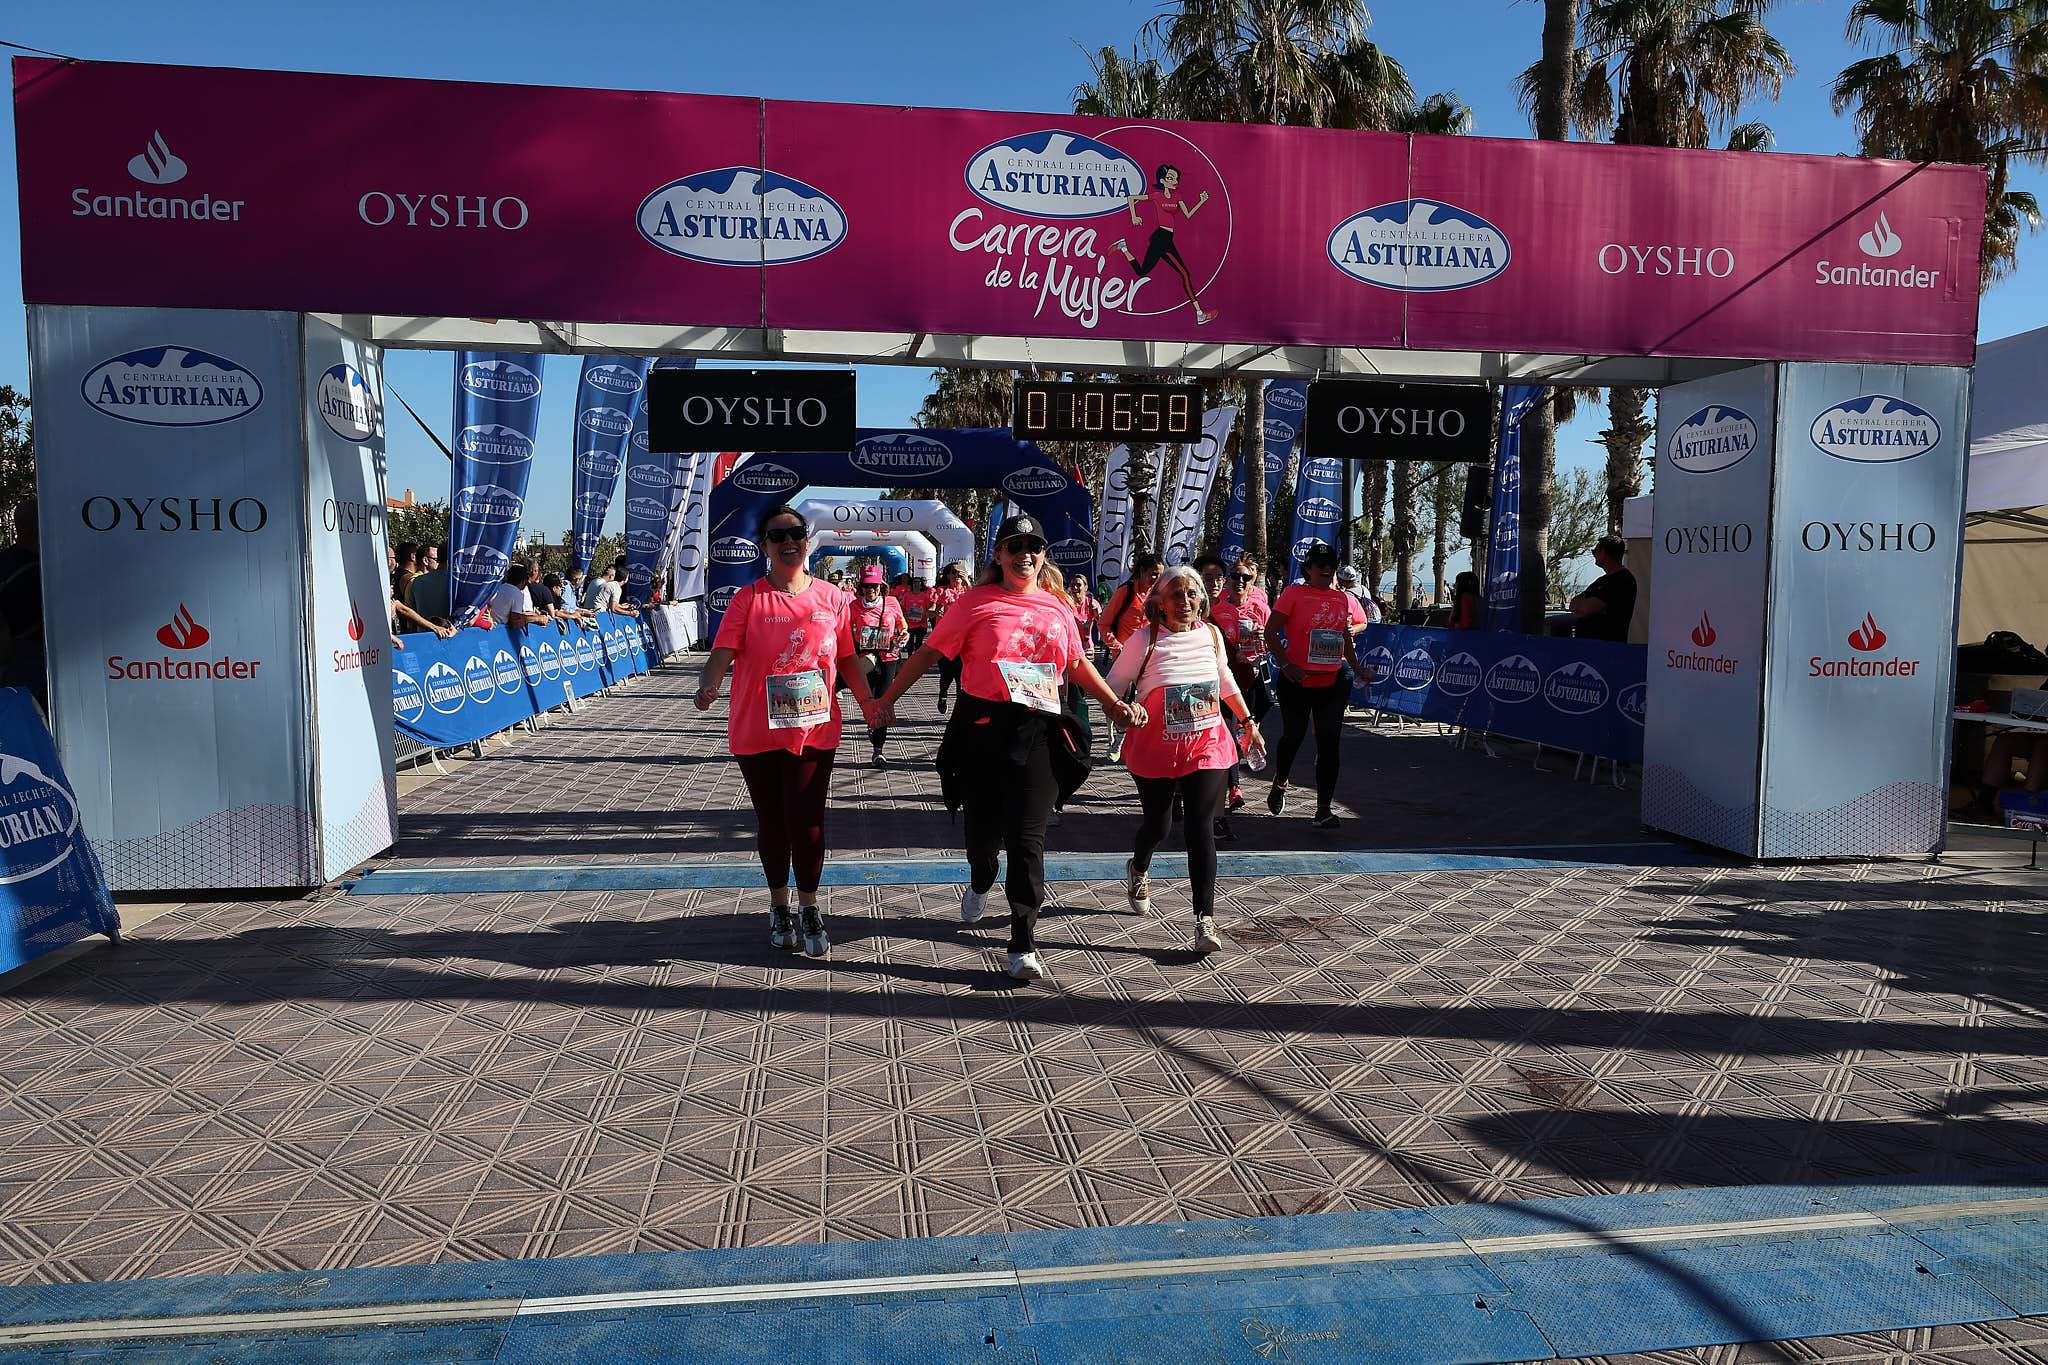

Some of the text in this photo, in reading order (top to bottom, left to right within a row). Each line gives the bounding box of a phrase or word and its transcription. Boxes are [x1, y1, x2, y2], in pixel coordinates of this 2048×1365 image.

[1007, 157, 1128, 173] CENTRAL LECHERA
[979, 158, 1132, 198] ASTURIANA
[71, 188, 245, 221] Santander
[358, 191, 529, 230] OYSHO
[686, 199, 752, 211] CENTRAL
[653, 200, 832, 242] ASTURIANA
[949, 207, 1098, 258] Carrera
[1370, 229, 1491, 242] CENTRAL LECHERA
[1341, 230, 1497, 269] ASTURIANA
[1598, 243, 1735, 278] OYSHO
[1815, 261, 1940, 289] Santander
[985, 254, 1152, 329] de la Mujer
[96, 374, 250, 407] ASTURIANA
[123, 373, 244, 384] CENTRAL LECHERA
[463, 370, 534, 393] ASTURIANA
[322, 384, 374, 429] ASTURIANA
[682, 394, 827, 427] OYSHO
[1027, 391, 1188, 432] 01:06:58
[1337, 406, 1465, 437] OYSHO
[1686, 422, 1748, 439] CENTRAL LECHERA
[1819, 419, 1930, 446] ASTURIANA
[1840, 418, 1927, 427] CENTRAL LECHERA
[461, 434, 528, 457] ASTURIANA
[856, 446, 945, 466] ASTURIANA
[1673, 432, 1750, 460] ASTURIANA
[737, 475, 794, 486] ASTURIANA
[1008, 478, 1063, 490] ASTURIANA
[81, 496, 268, 533] OYSHO
[323, 498, 380, 535] OYSHO
[457, 496, 519, 517] ASTURIANA
[833, 505, 914, 523] OYSHO
[1665, 523, 1752, 555] OYSHO
[1801, 521, 1936, 552] OYSHO
[711, 549, 756, 558] ASTURIANA
[108, 656, 260, 680] Santander
[333, 648, 380, 673] Santander
[1397, 662, 1431, 681] ASTURIANA
[1666, 650, 1739, 675] Santander
[1809, 656, 1919, 677] Santander
[1439, 666, 1477, 686] ASTURIANA
[1488, 671, 1535, 693] ASTURIANA
[428, 683, 464, 704] ASTURIANA
[1547, 679, 1601, 704] ASTURIANA
